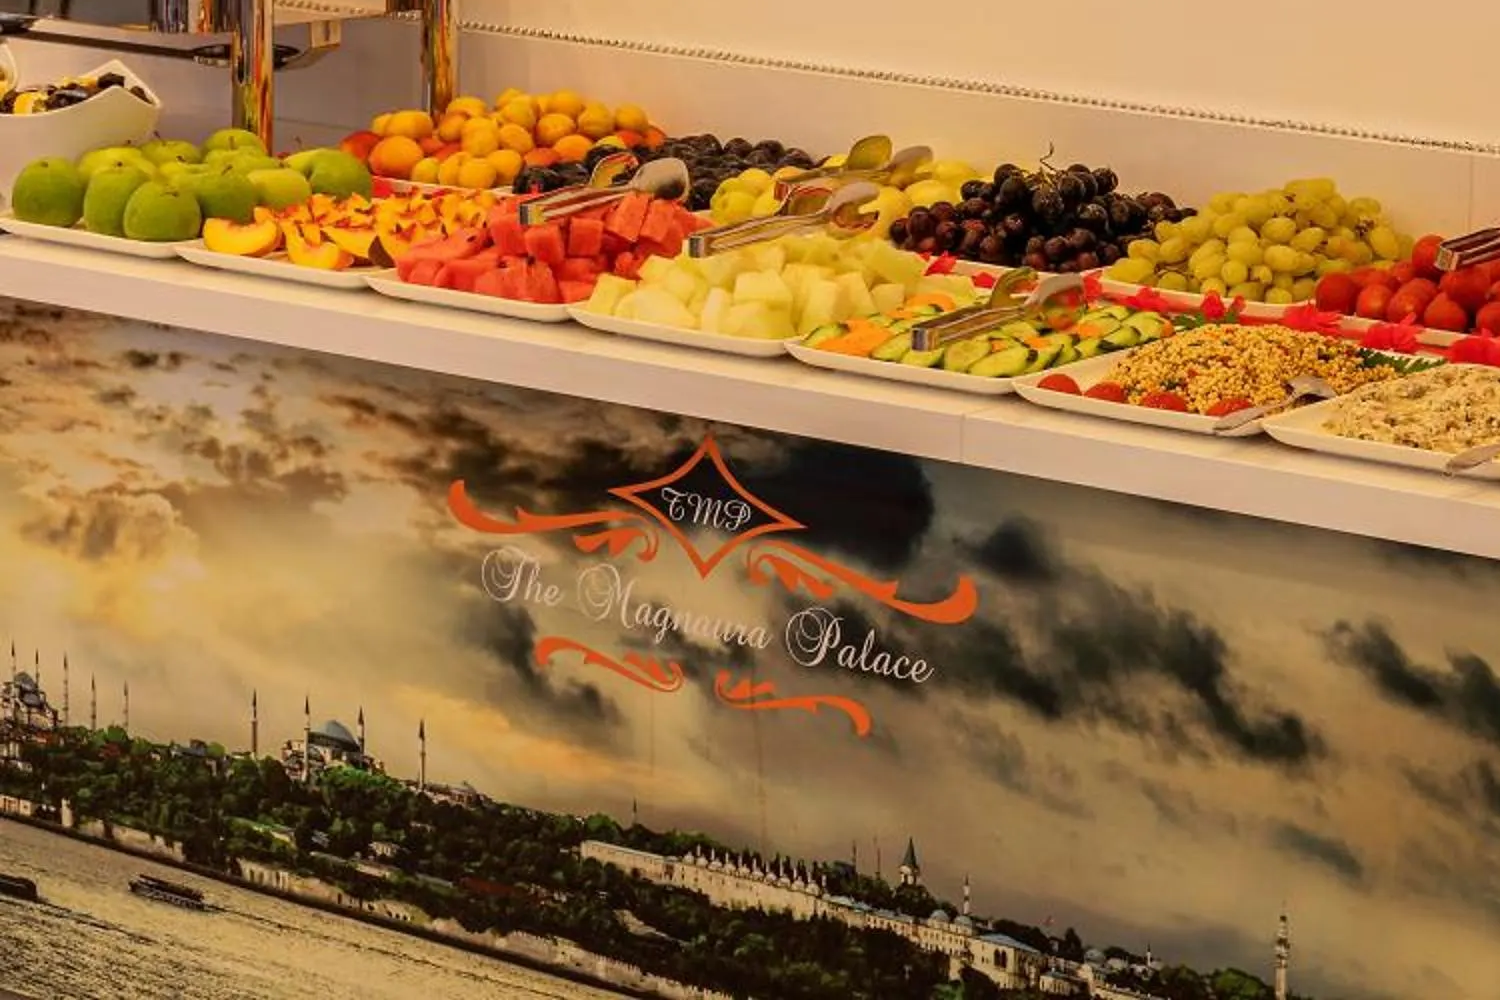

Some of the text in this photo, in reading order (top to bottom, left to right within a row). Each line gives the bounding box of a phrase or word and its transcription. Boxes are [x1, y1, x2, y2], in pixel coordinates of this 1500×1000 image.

[661, 487, 751, 532] TMP
[481, 545, 935, 683] The Magnaura Palace
